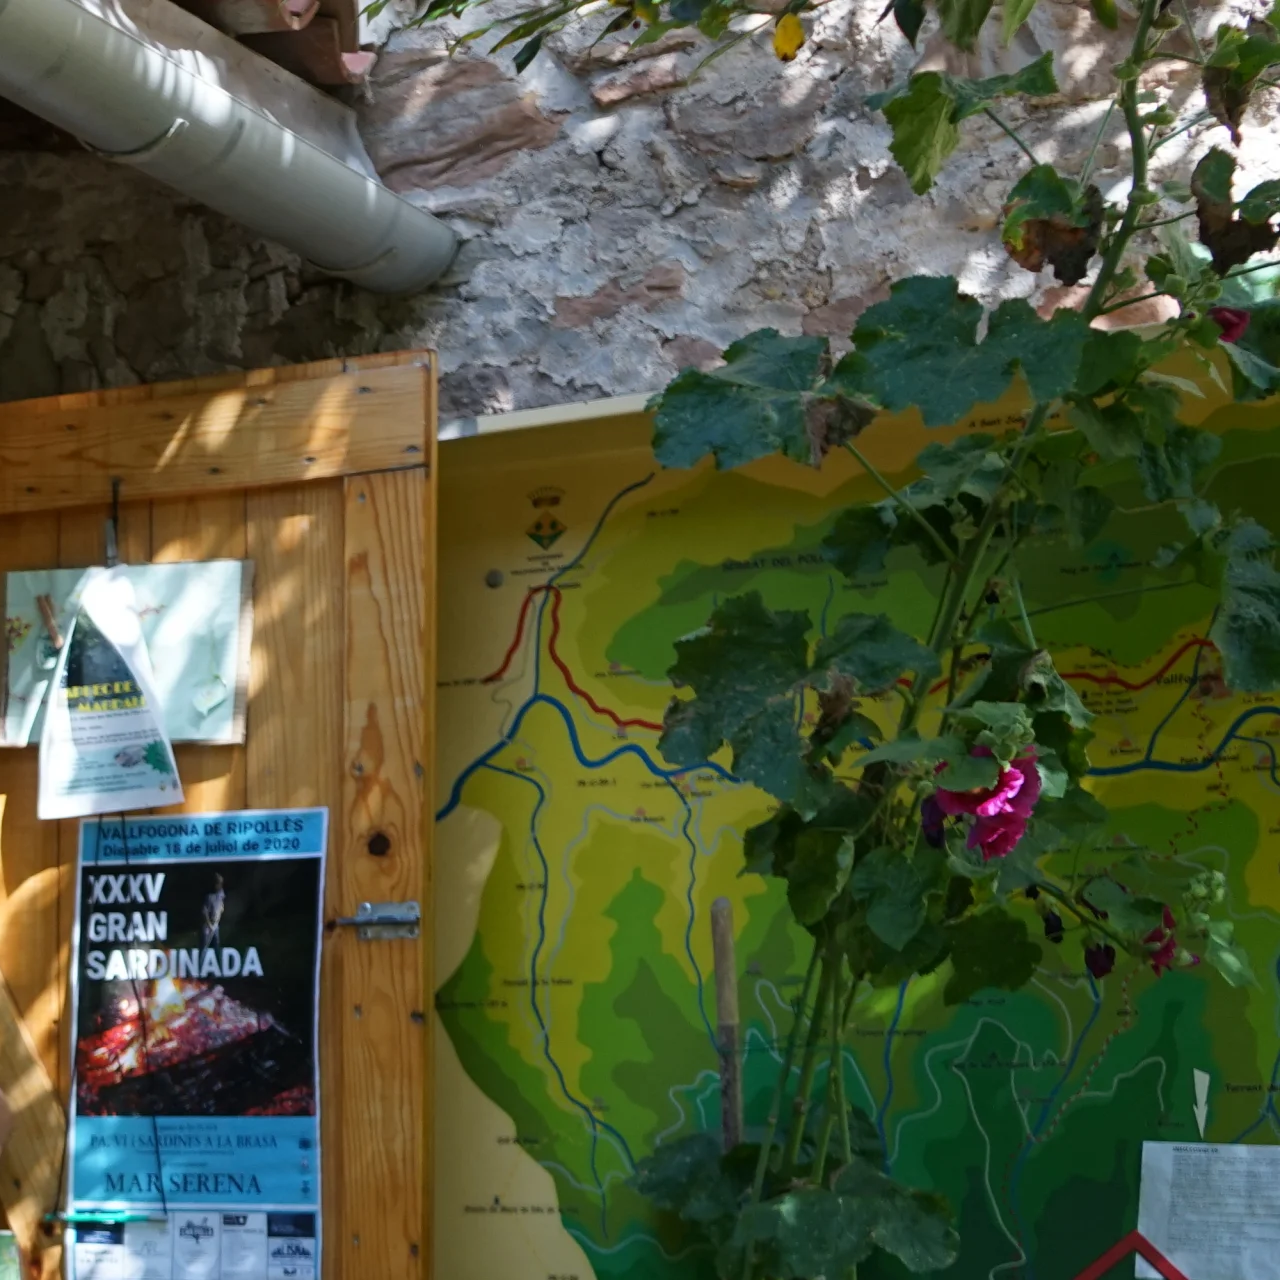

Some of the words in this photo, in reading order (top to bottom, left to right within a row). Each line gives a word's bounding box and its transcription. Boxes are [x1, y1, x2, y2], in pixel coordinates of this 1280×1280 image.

[100, 822, 200, 840] VALLFOGONA
[204, 821, 222, 836] DE
[227, 814, 304, 835] RIPOLLÈS
[186, 841, 202, 854] de
[205, 840, 239, 857] juliol
[243, 839, 259, 852] de
[263, 837, 301, 851] 2020
[88, 873, 166, 905] XXXV
[89, 911, 168, 942] GRAN
[86, 947, 265, 981] SARDINADA
[137, 1133, 201, 1150] SARDINES
[203, 1134, 215, 1149] A
[217, 1134, 235, 1149] LA
[237, 1134, 278, 1150] BRASA
[105, 1172, 162, 1194] MAR
[169, 1173, 263, 1196] SERENA
